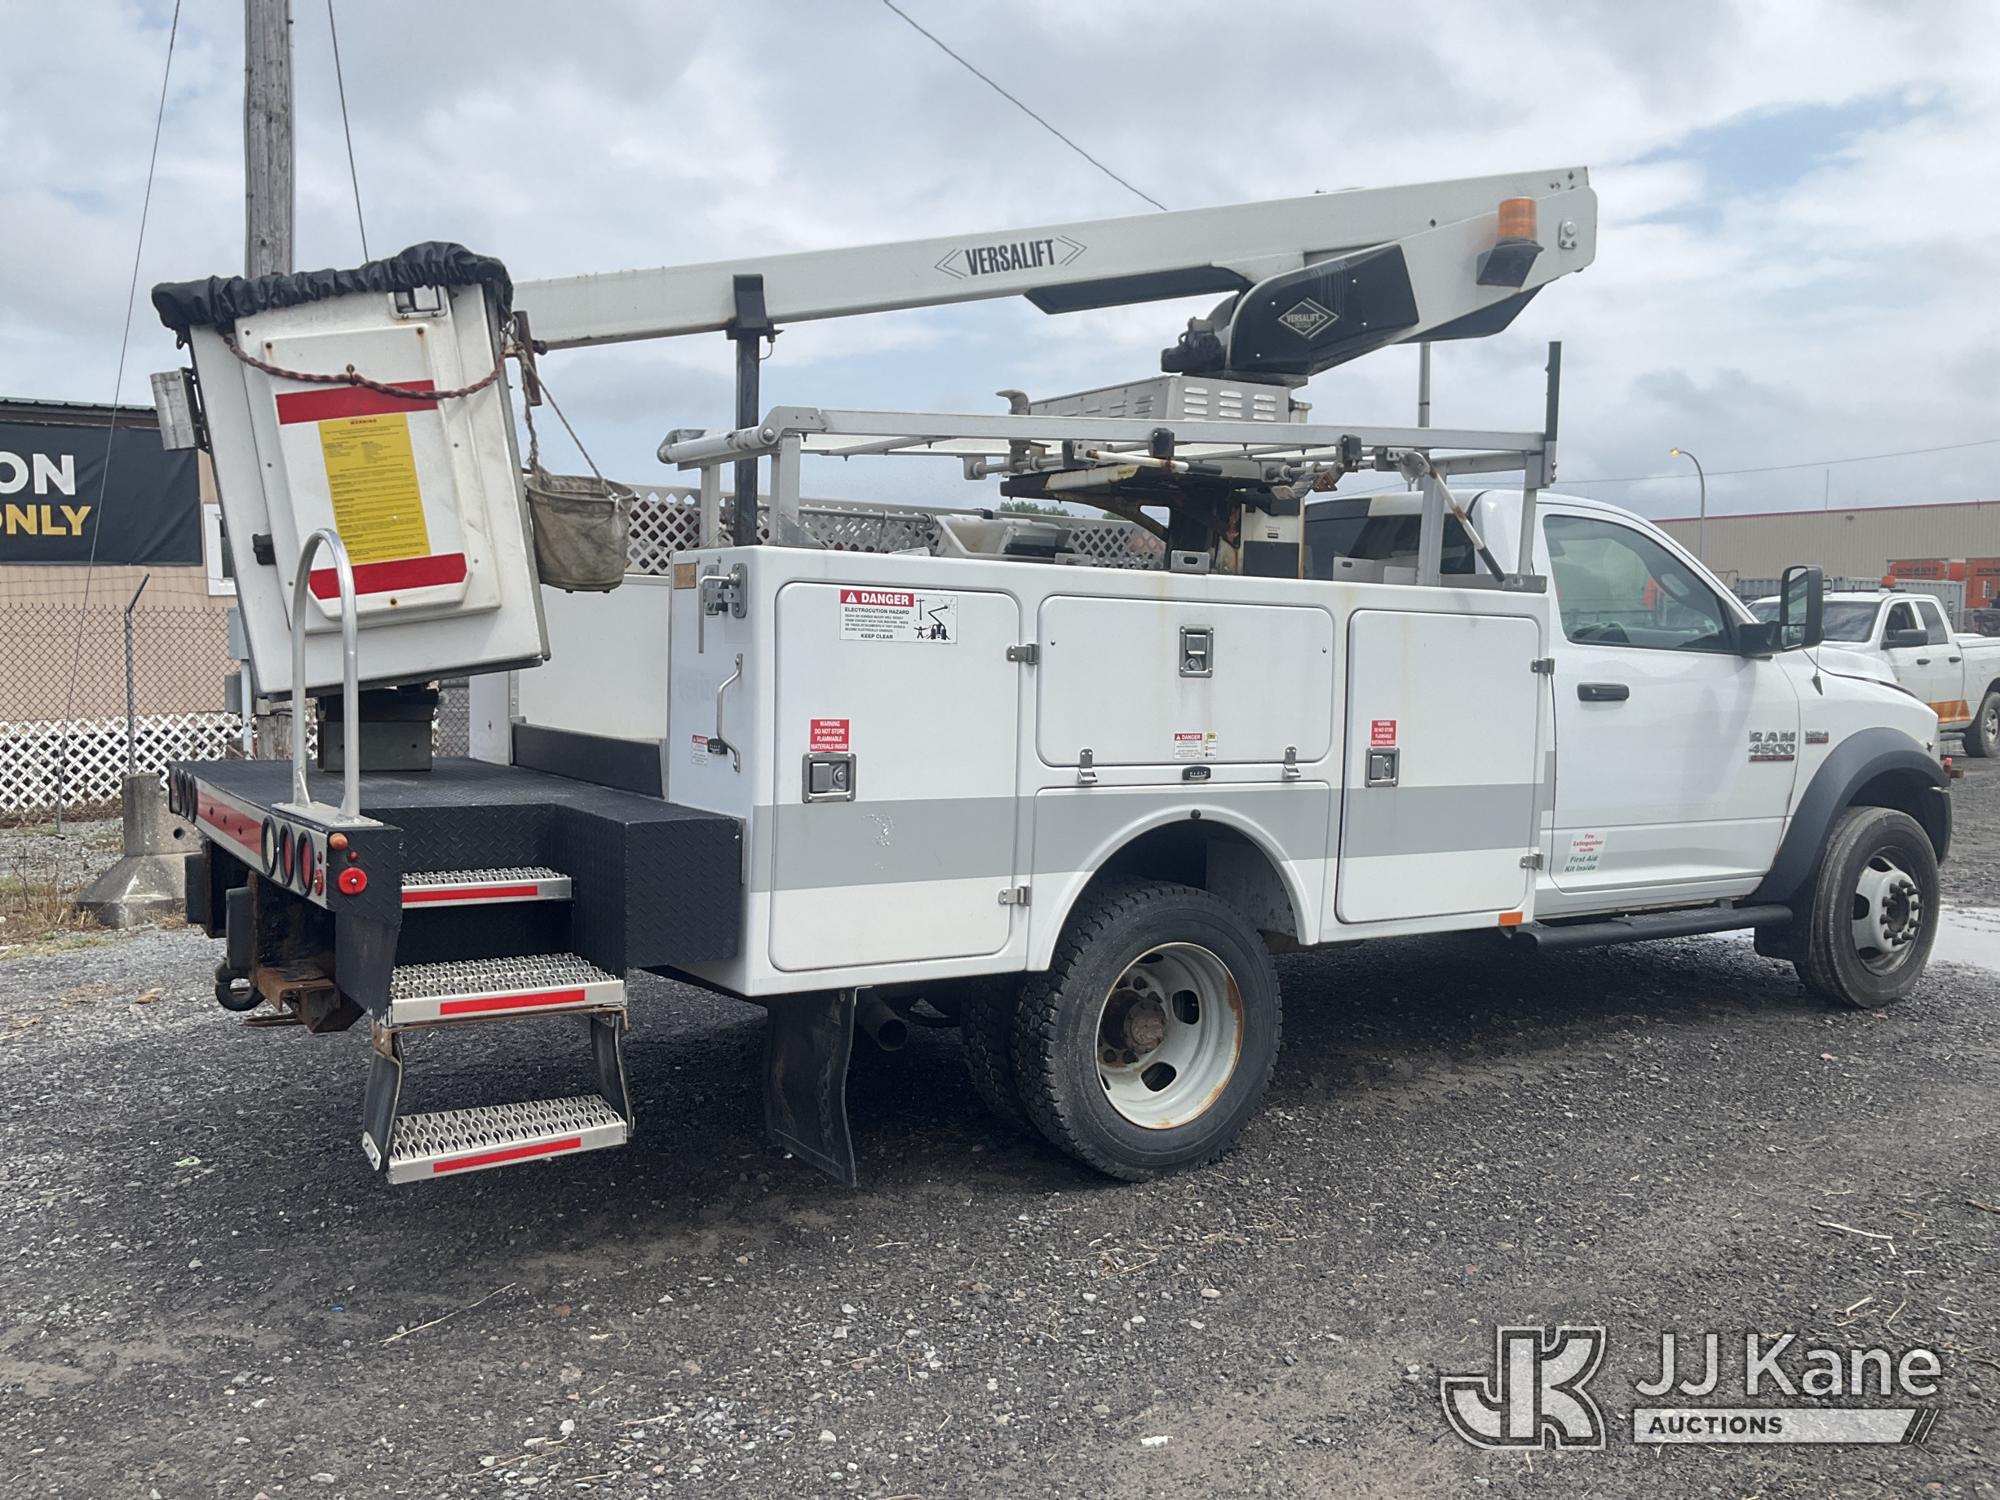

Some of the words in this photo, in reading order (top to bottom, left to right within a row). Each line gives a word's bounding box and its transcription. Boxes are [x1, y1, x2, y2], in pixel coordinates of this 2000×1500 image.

[964, 239, 1055, 276] VERSALIFT
[0, 451, 76, 495] ON
[0, 503, 91, 536] NLY
[861, 593, 910, 605] DANGER
[1748, 731, 1796, 742] RAM
[1748, 743, 1796, 754] 4500
[1569, 855, 1586, 863] First
